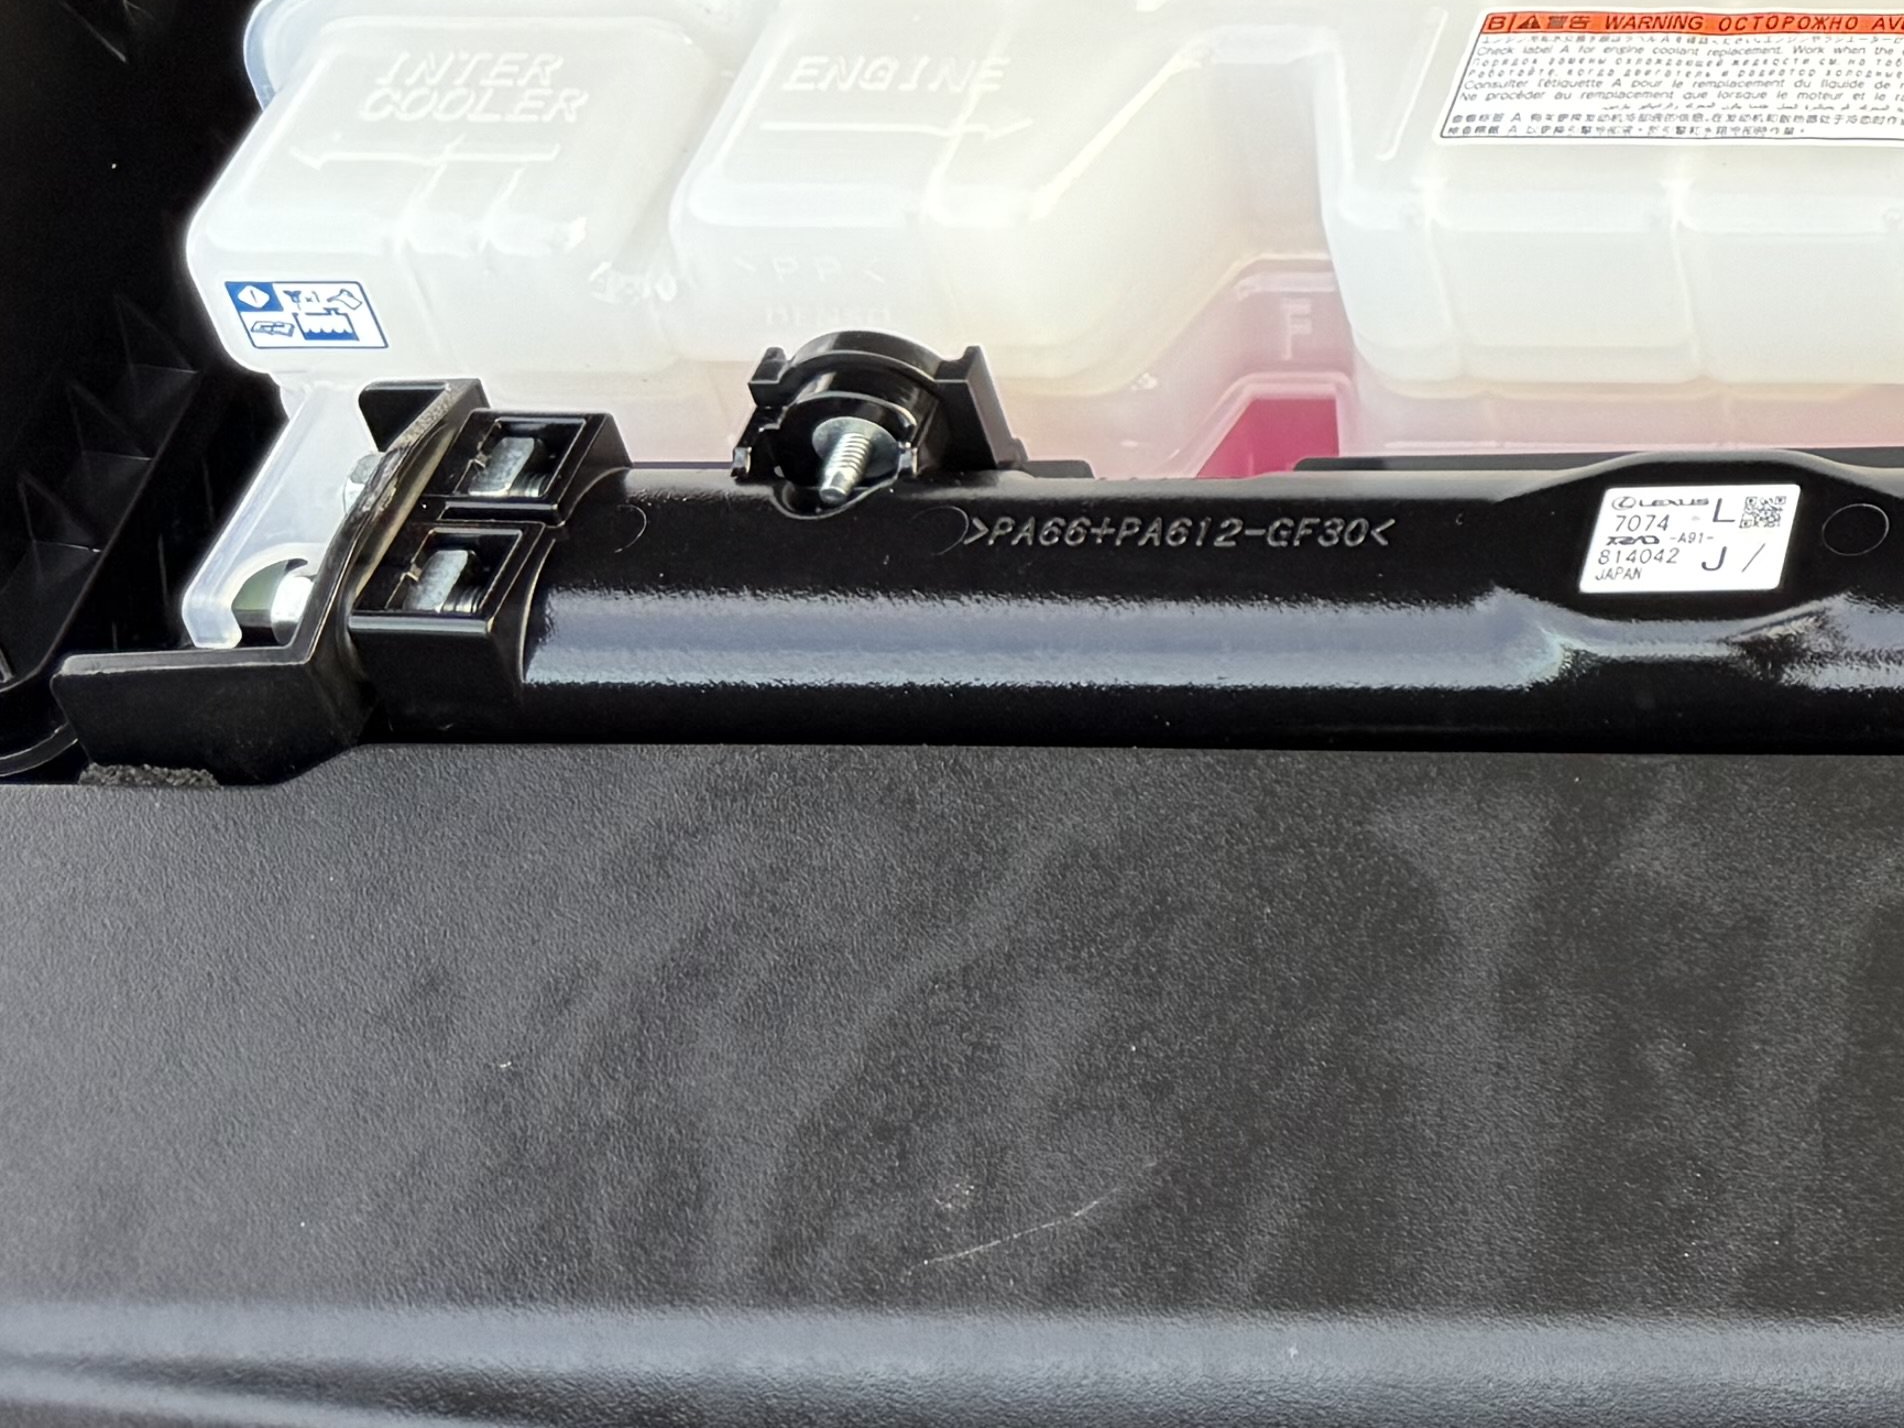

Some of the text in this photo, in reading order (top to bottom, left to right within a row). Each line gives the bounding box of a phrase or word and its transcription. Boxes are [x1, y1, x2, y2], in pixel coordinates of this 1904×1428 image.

[1604, 15, 1703, 30] WARNING
[1718, 16, 1858, 32] ОСТОРОЖНО
[1477, 46, 1513, 56] Check
[1523, 45, 1553, 54] label
[1560, 45, 1569, 53] A
[1579, 45, 1595, 53] for
[1603, 46, 1644, 56] engine
[1652, 46, 1699, 56] coolant
[1793, 45, 1824, 55] Work
[1834, 46, 1866, 55] when
[1875, 46, 1894, 55] the
[374, 51, 564, 85] INTER
[781, 55, 1011, 92] ENGINE
[1631, 80, 1663, 88] pour
[1692, 80, 1785, 89] remplacement
[1794, 79, 1811, 88] du
[1874, 80, 1891, 89] de
[358, 85, 590, 124] COOLER
[1581, 91, 1674, 100] remplacement
[1797, 91, 1844, 101] moteur
[1639, 498, 1735, 522] LEXUS L
[1615, 514, 1670, 532] 7074
[1598, 547, 1680, 565] 814042
[1701, 546, 1728, 571] J
[1595, 567, 1642, 581] JAPAN
